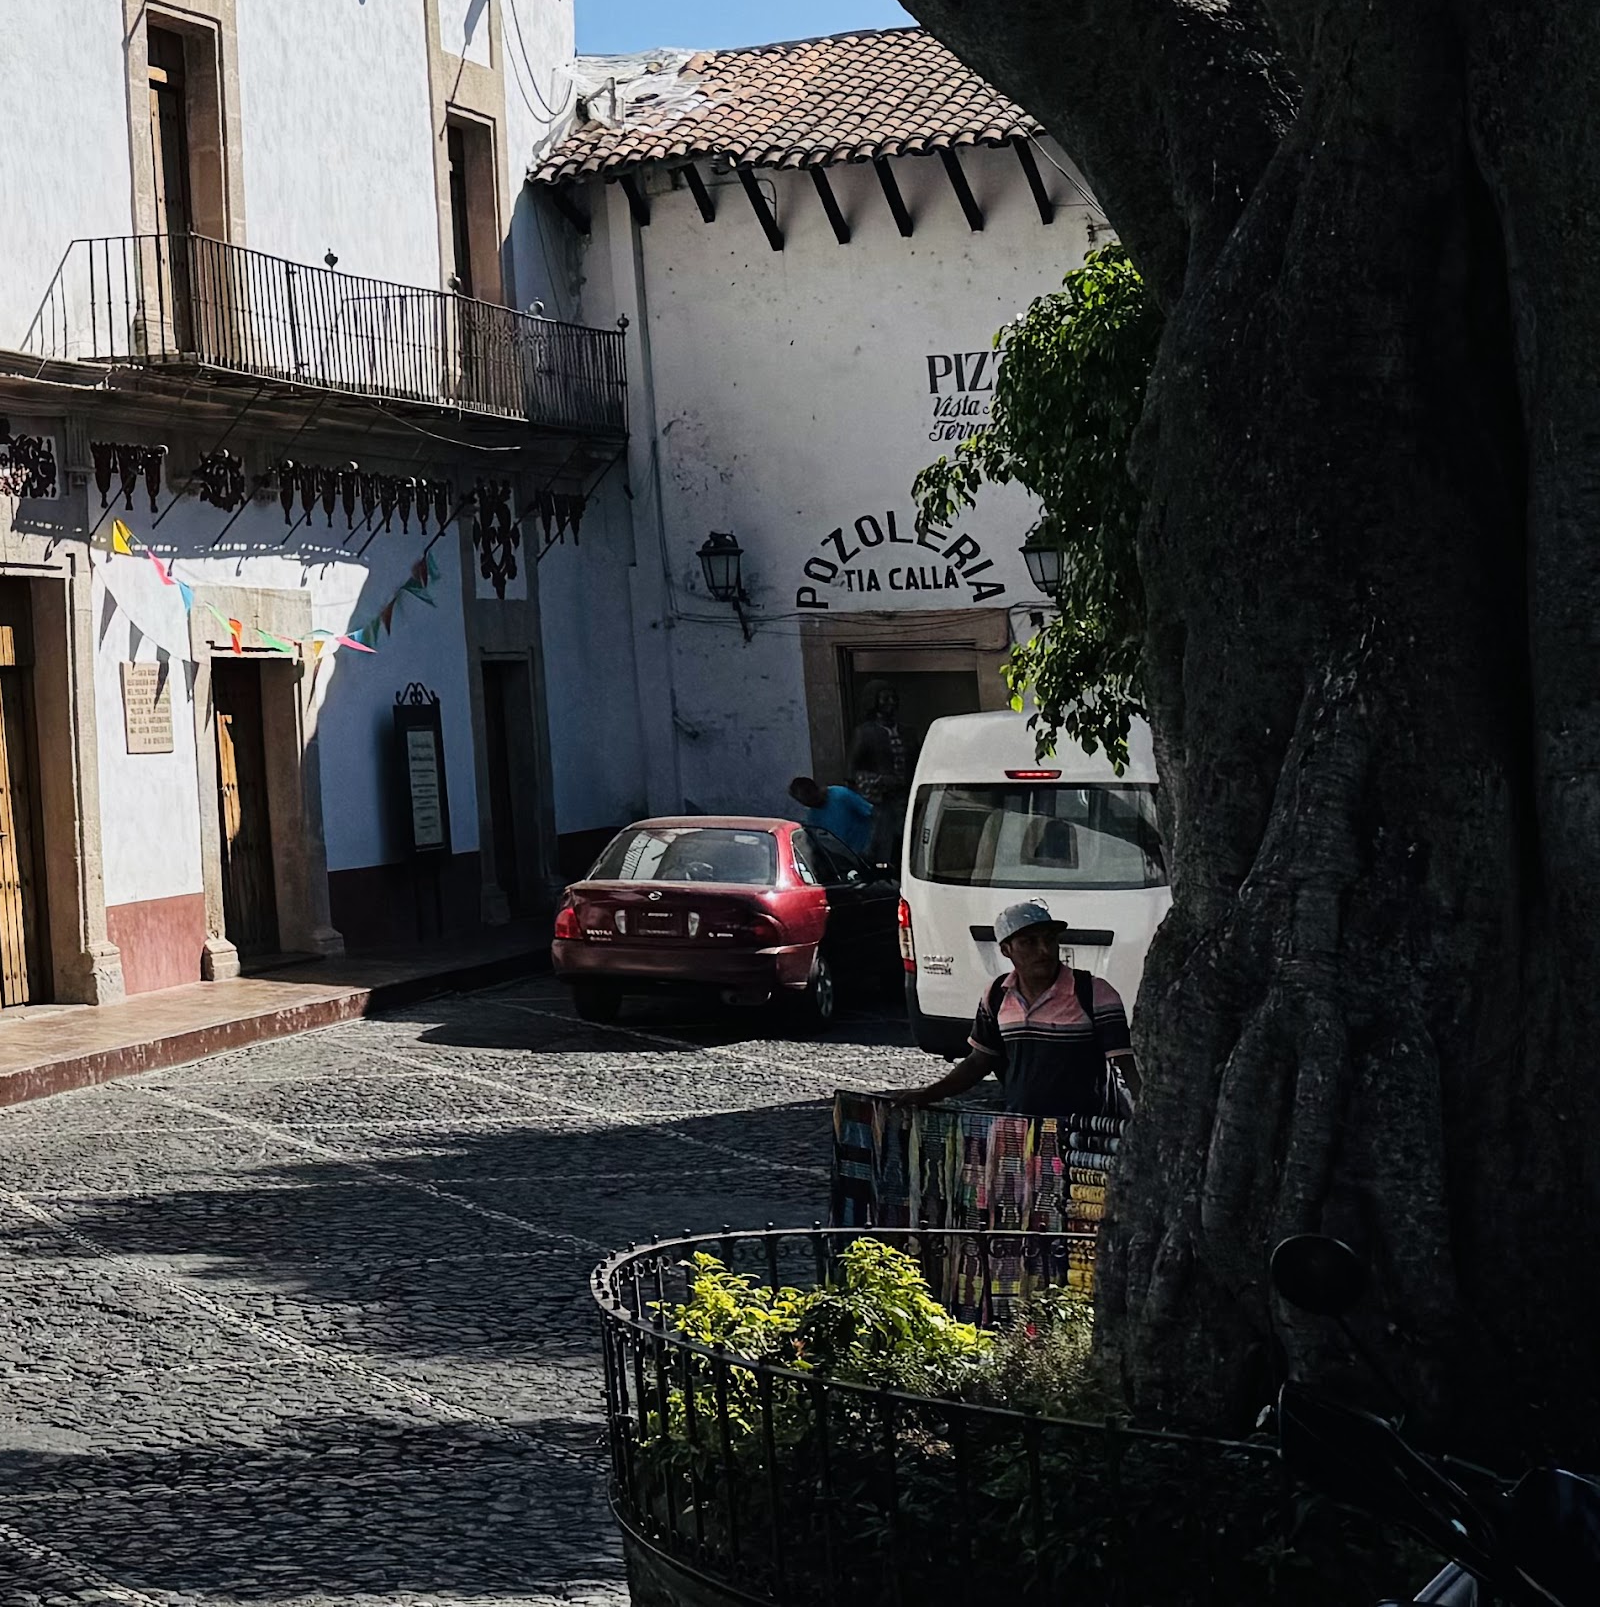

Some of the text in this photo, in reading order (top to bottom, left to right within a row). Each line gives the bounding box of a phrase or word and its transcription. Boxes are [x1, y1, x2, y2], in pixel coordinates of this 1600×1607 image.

[933, 395, 980, 417] Vista
[796, 511, 1006, 609] POZOLERIA
[844, 566, 960, 592] TIA CALLA
